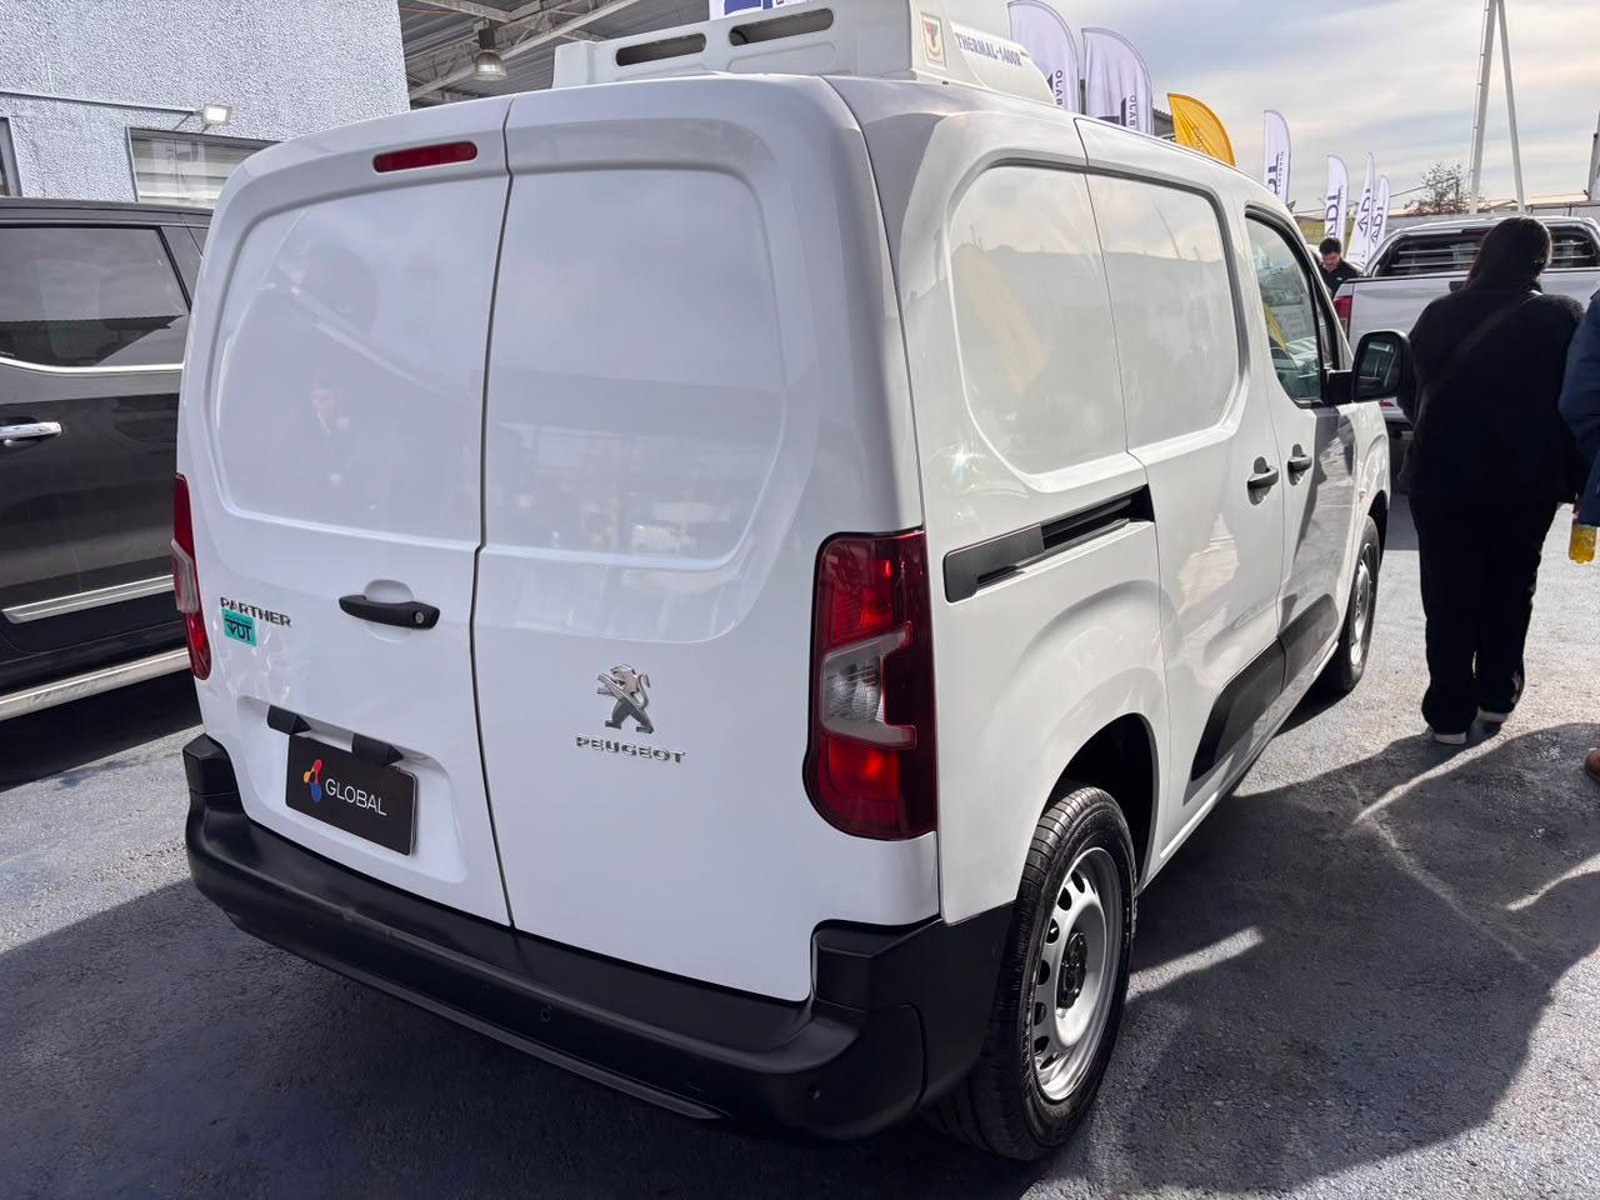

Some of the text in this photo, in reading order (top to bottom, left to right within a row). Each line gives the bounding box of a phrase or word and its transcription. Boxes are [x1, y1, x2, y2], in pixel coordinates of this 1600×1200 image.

[220, 597, 292, 627] PARTNER
[576, 736, 686, 764] PEUGEOT
[325, 778, 388, 816] GLOBAL
